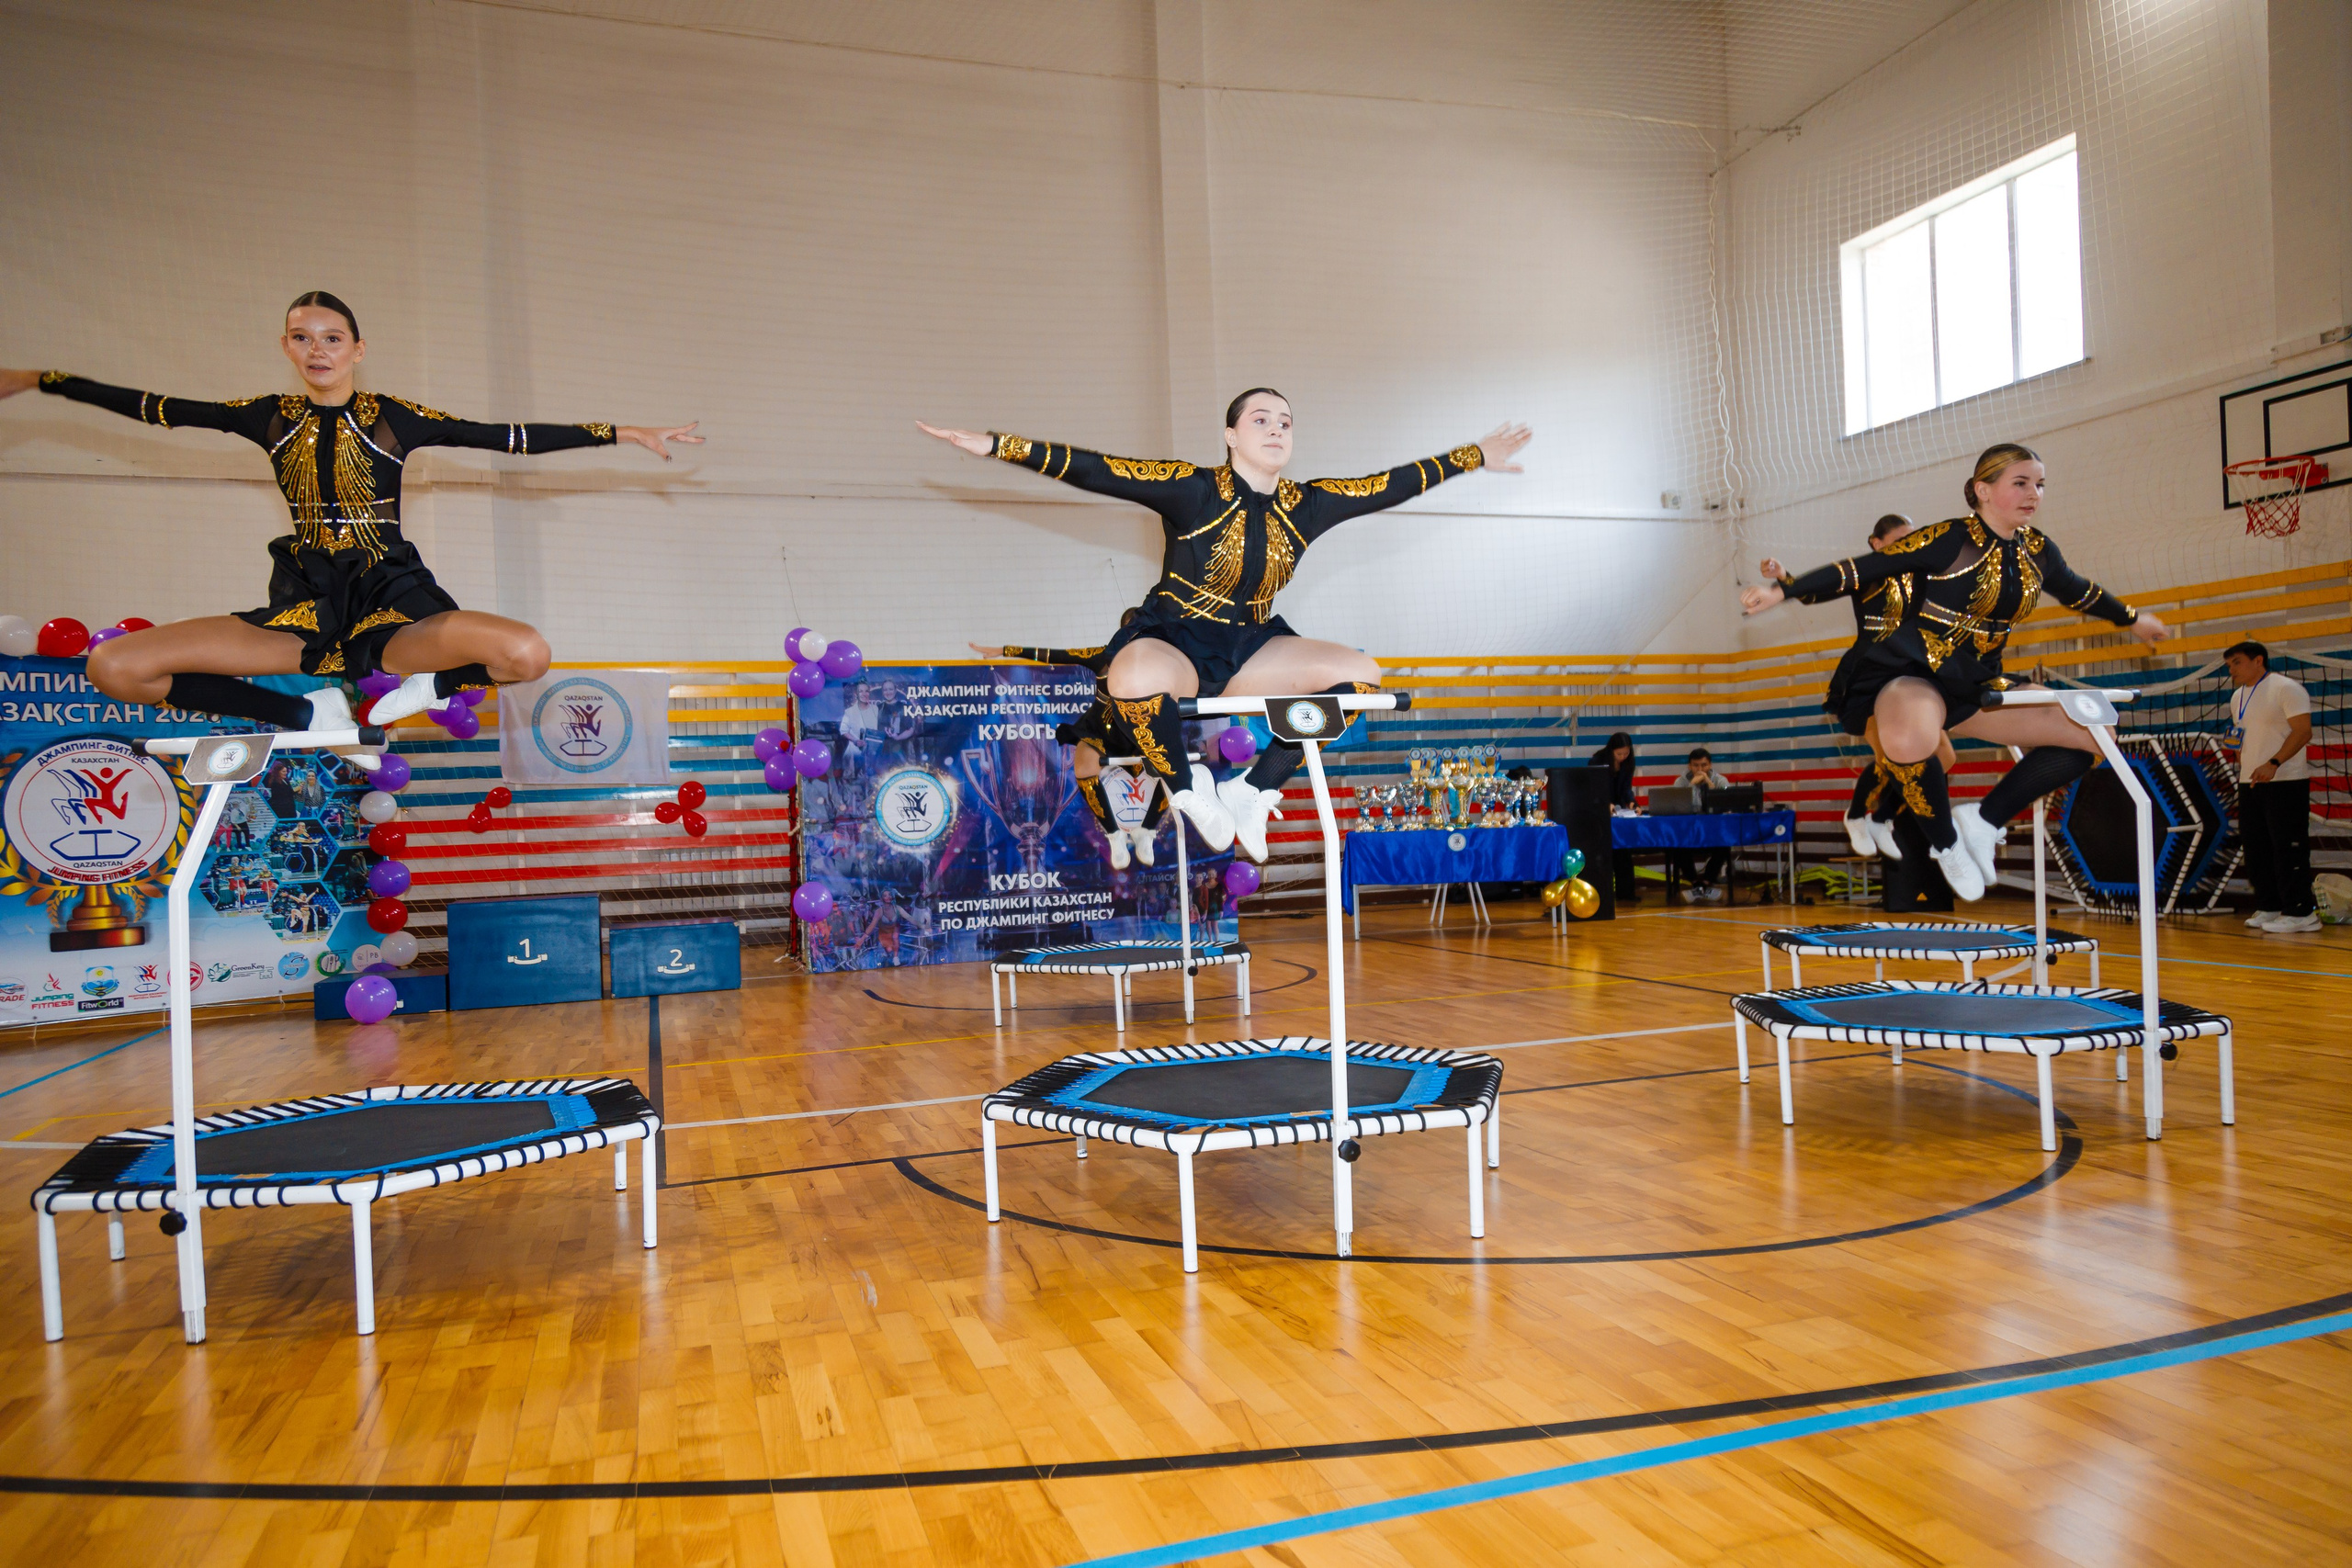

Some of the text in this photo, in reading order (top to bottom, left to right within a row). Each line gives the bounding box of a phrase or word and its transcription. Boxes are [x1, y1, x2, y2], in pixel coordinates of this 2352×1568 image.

[906, 684, 991, 700] ДЖАМПИНГ
[995, 684, 1051, 697] ФИТНЕС
[0, 702, 222, 726] ЗАҚСТАН 202
[903, 703, 988, 718] ҚАЗАҚСТАН
[37, 741, 149, 767] ДЖАМПИНГ-ФИТНЕС
[47, 859, 148, 883] JUMPING FITNESS
[73, 860, 123, 869] QAZAQSTAN
[990, 872, 1062, 891] КУБОК
[938, 892, 1113, 914] РЕСПУБЛИКИ КАЗАХСТАН
[941, 908, 1115, 931] ПО ДЖАМПИНГ ФИТНЕСУ
[519, 938, 530, 958] 1
[670, 948, 683, 966] 2
